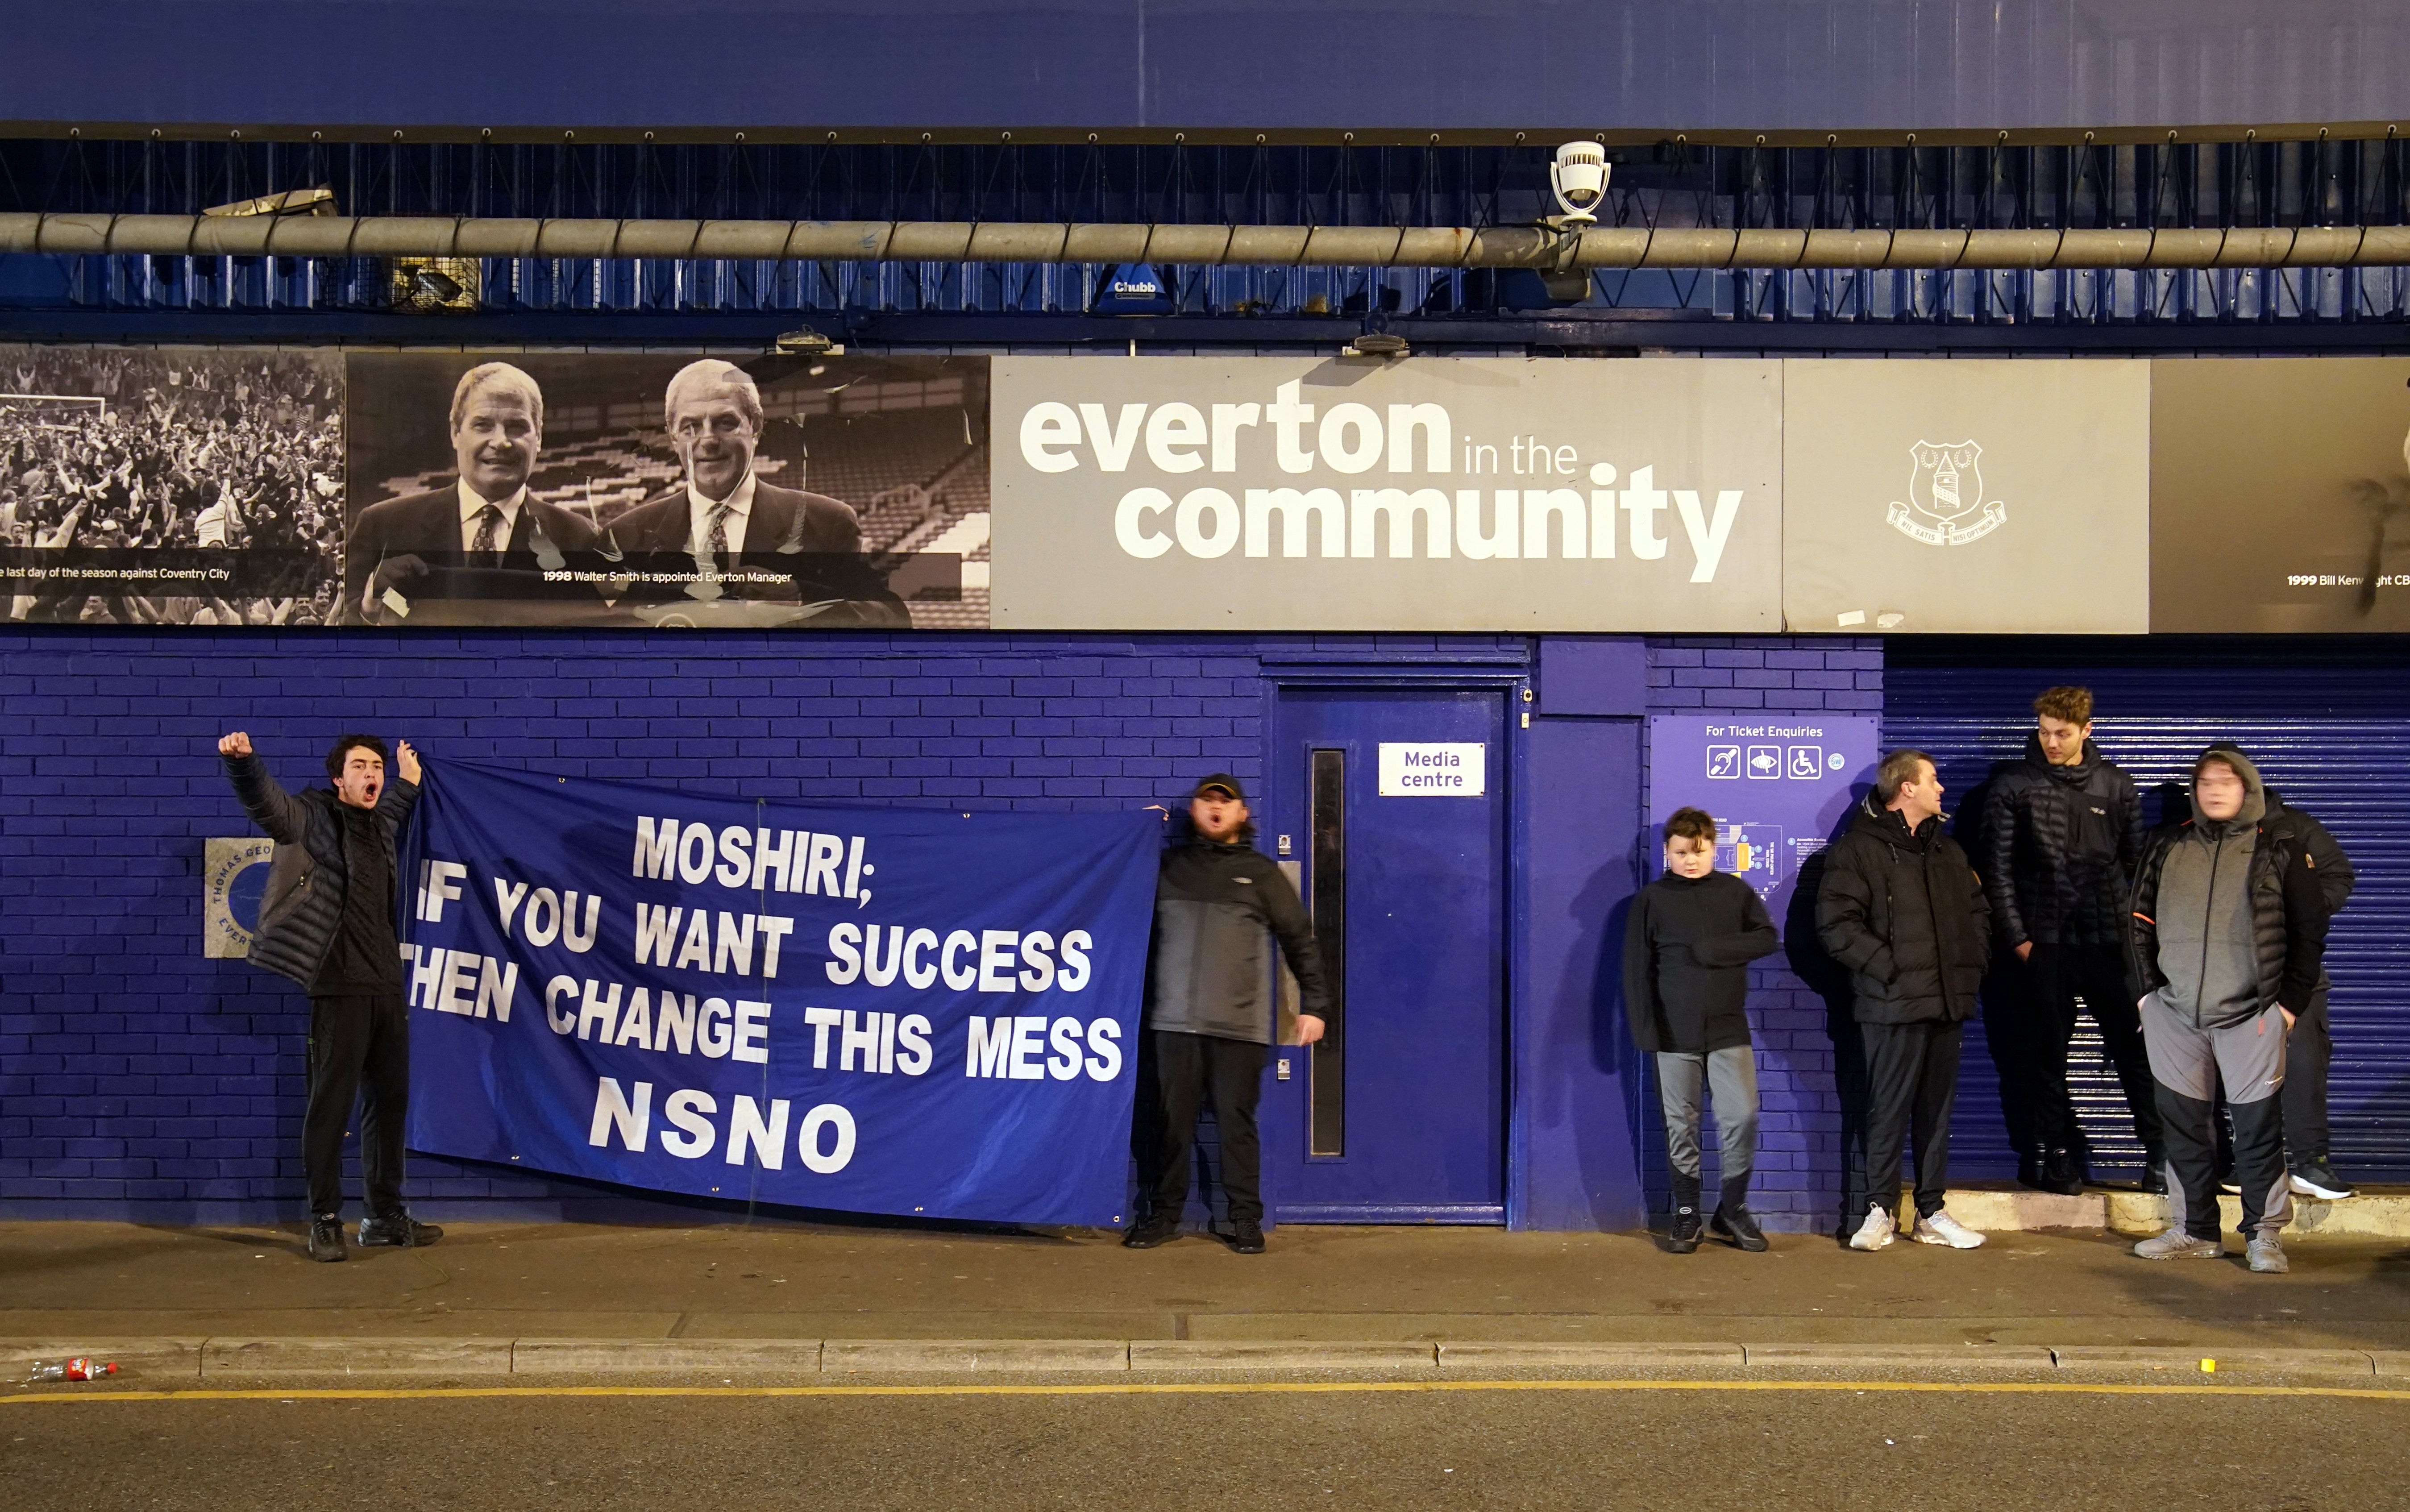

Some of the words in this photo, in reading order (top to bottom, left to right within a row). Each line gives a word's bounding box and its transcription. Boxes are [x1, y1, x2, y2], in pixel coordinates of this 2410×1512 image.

[1114, 282, 1156, 292] Chubb
[1020, 378, 1451, 474] everton
[1465, 436, 1497, 474] in
[1513, 436, 1578, 474] the
[1115, 463, 1744, 583] community
[1901, 520, 1912, 531] NIL
[1915, 529, 1936, 541] SATIS
[1953, 533, 1966, 542] NISI
[1967, 519, 1995, 538] OPTIMUM
[7, 567, 25, 577] last
[28, 568, 46, 580] day
[49, 567, 60, 577] of
[62, 568, 79, 577] the
[120, 568, 157, 580] against
[160, 568, 207, 580] Coventry
[209, 568, 230, 580] City
[543, 572, 572, 581] 1998
[574, 572, 607, 581] Walter
[610, 572, 640, 582] Smith
[642, 572, 650, 582] is
[652, 572, 703, 583] appointed
[706, 572, 745, 582] Everton
[748, 573, 792, 584] Manager
[2287, 575, 2317, 586] 1999
[2319, 575, 2335, 586] Bill
[2395, 575, 2410, 586] CB
[1706, 726, 1724, 736] For
[1728, 726, 1764, 736] Ticket
[1768, 726, 1823, 739] Enquiries
[1405, 751, 1459, 766] Media
[1402, 772, 1463, 786] centre
[633, 816, 875, 909] MOSHIRI;
[212, 855, 241, 904] THOMAS
[245, 846, 270, 857] GEO
[416, 859, 467, 922] IF
[494, 877, 601, 953] YOU
[635, 903, 794, 978] WANT
[826, 922, 1093, 992] SUCCESS
[545, 975, 772, 1064] CHANGE
[805, 1007, 933, 1076] THIS
[966, 1015, 1122, 1082] MESS
[589, 1076, 856, 1174] NSNO
